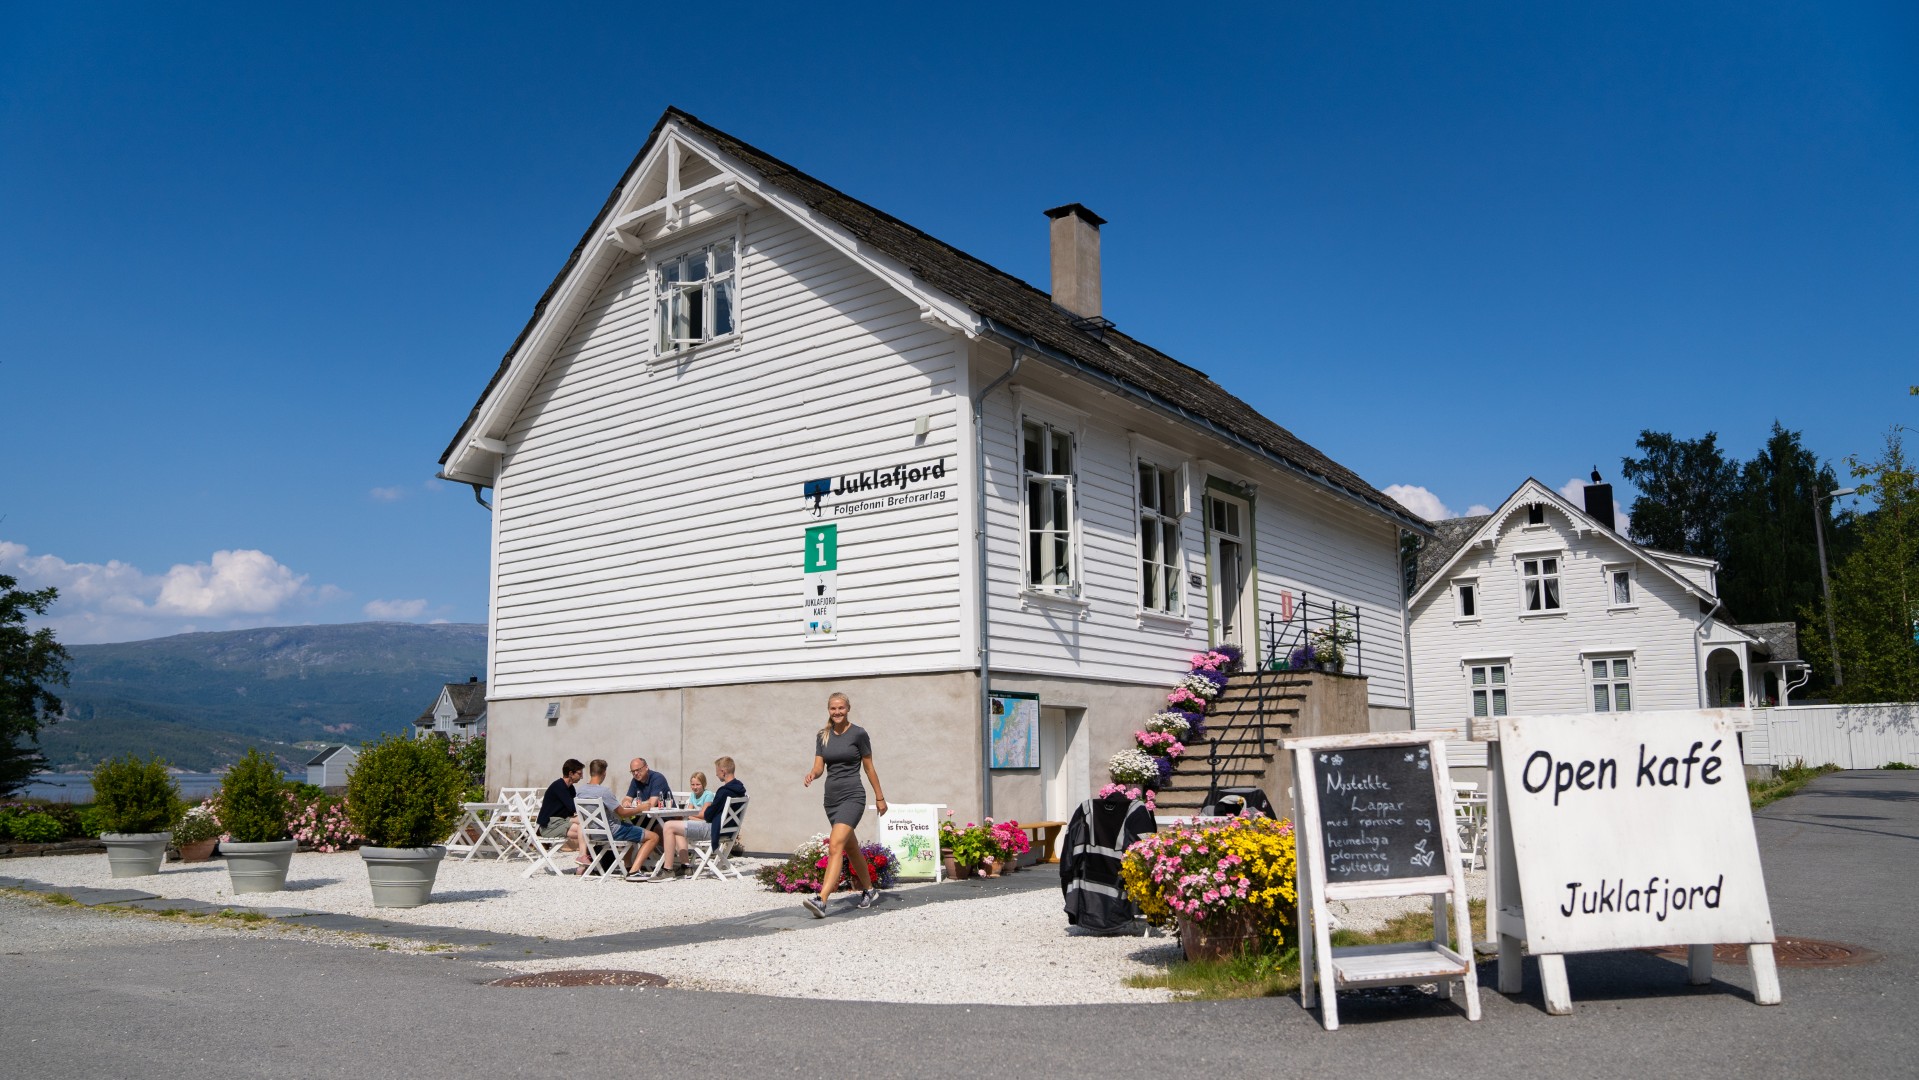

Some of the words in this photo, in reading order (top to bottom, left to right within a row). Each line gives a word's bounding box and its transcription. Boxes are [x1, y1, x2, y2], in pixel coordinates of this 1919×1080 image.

[834, 458, 945, 496] Juklafjord
[834, 498, 884, 515] Folgefonni
[805, 597, 836, 607] JUKLAFJORD
[813, 606, 827, 616] KAFÉ
[1326, 770, 1391, 796] Nysteikte
[1522, 750, 1617, 806] Open
[1636, 739, 1723, 789] kafé
[1351, 796, 1405, 818] Lappar
[1326, 818, 1348, 827] med
[1416, 819, 1432, 833] og
[1328, 830, 1389, 851] heimelaga
[1330, 849, 1388, 865] plomme
[1561, 873, 1724, 922] Juklafjord
